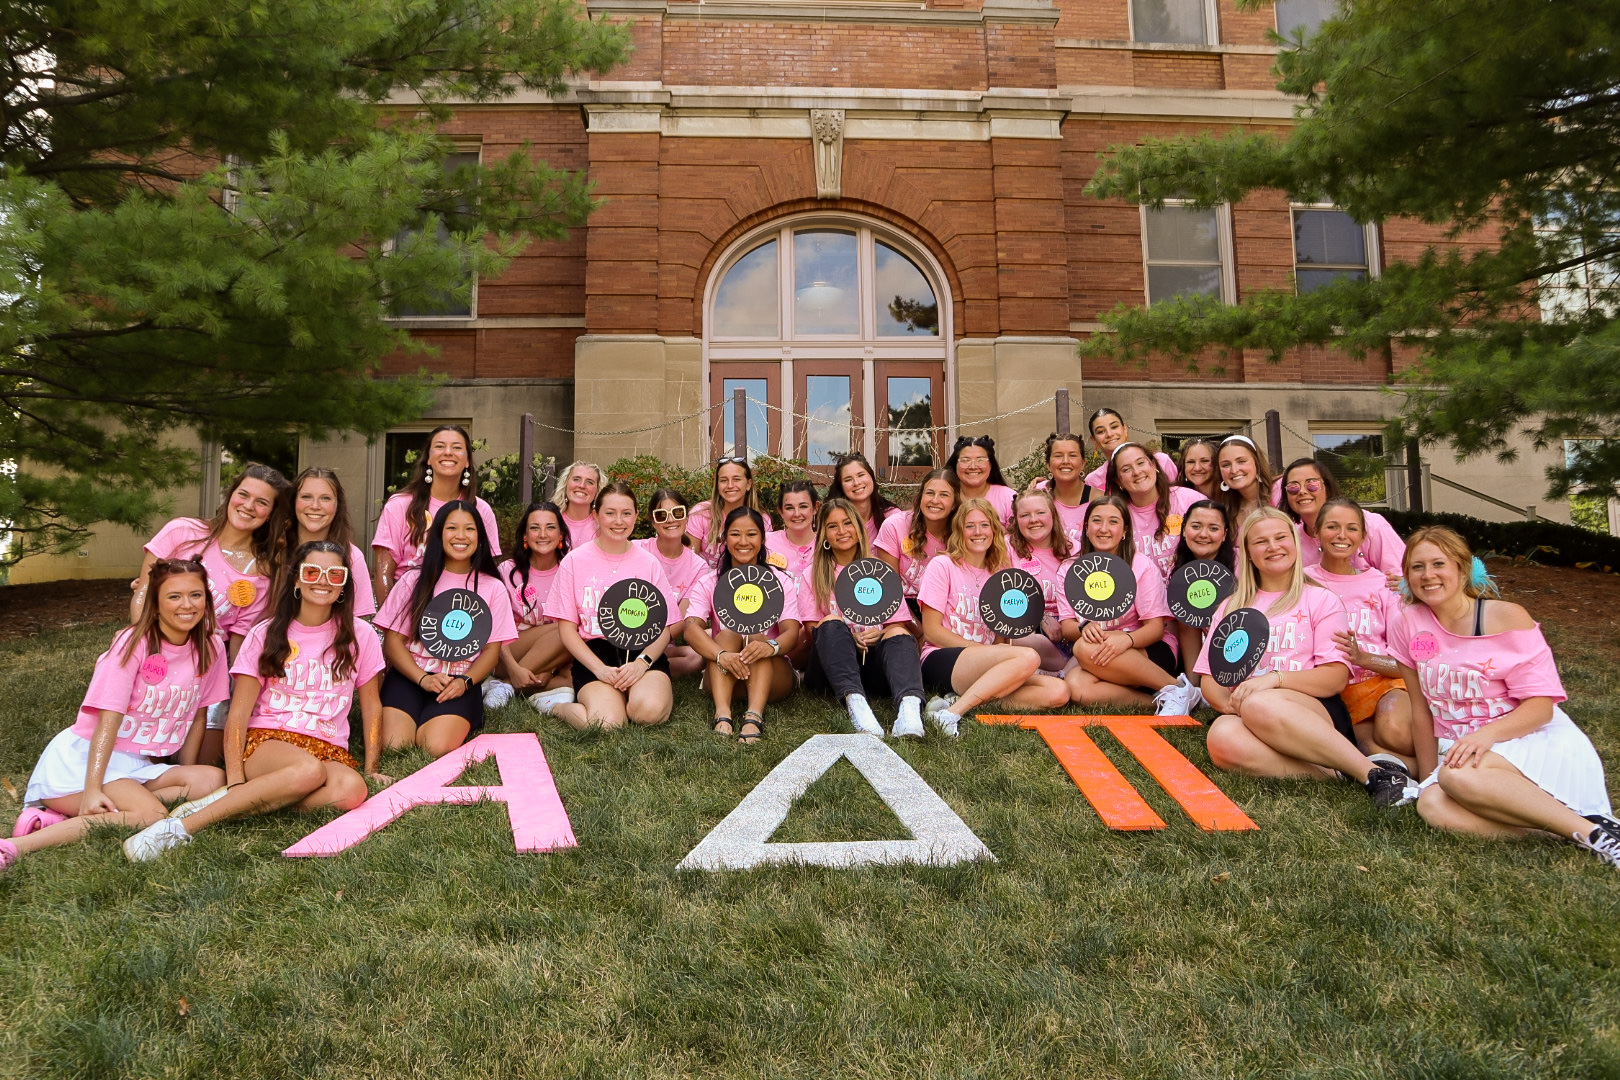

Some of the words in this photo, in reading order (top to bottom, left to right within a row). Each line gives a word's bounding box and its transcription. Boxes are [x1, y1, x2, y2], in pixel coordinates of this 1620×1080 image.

[846, 559, 893, 583] ADPI
[1074, 555, 1112, 582] ADPI
[1184, 562, 1231, 587] ADPI
[727, 565, 783, 600] ADPI
[857, 586, 875, 595] BELA
[1000, 572, 1040, 603] ADPI
[1089, 580, 1107, 589] KALI
[451, 592, 484, 622] ADPI
[628, 581, 661, 611] ADPI
[735, 593, 757, 603] ANNIE
[1074, 599, 1094, 616] BID
[1095, 606, 1115, 618] DAY
[1117, 592, 1134, 613] 2023
[445, 619, 466, 631] LILY
[717, 608, 736, 628] BID
[737, 623, 756, 634] DAY
[757, 615, 780, 632] 2023
[843, 607, 862, 623] BID
[864, 614, 882, 625] DAY
[881, 599, 900, 620] 2023
[980, 603, 996, 623] BID
[994, 621, 1013, 635] DAY
[1013, 624, 1033, 636] 2023
[1171, 602, 1187, 618] BID
[1185, 613, 1203, 627] DAY
[420, 615, 438, 641] BID
[599, 607, 616, 630] BID
[608, 626, 633, 647] DAY
[634, 622, 662, 646] 2023
[1212, 611, 1248, 649] ADPI
[428, 640, 453, 658] DAY
[453, 639, 480, 657] 2023
[1411, 640, 1435, 651] JESSA
[142, 662, 165, 677] LAUREN
[279, 658, 347, 691] ALPH
[1217, 671, 1233, 684] BID
[1233, 664, 1247, 683] DAY
[1249, 641, 1266, 668] 2023
[285, 711, 317, 731] PI
